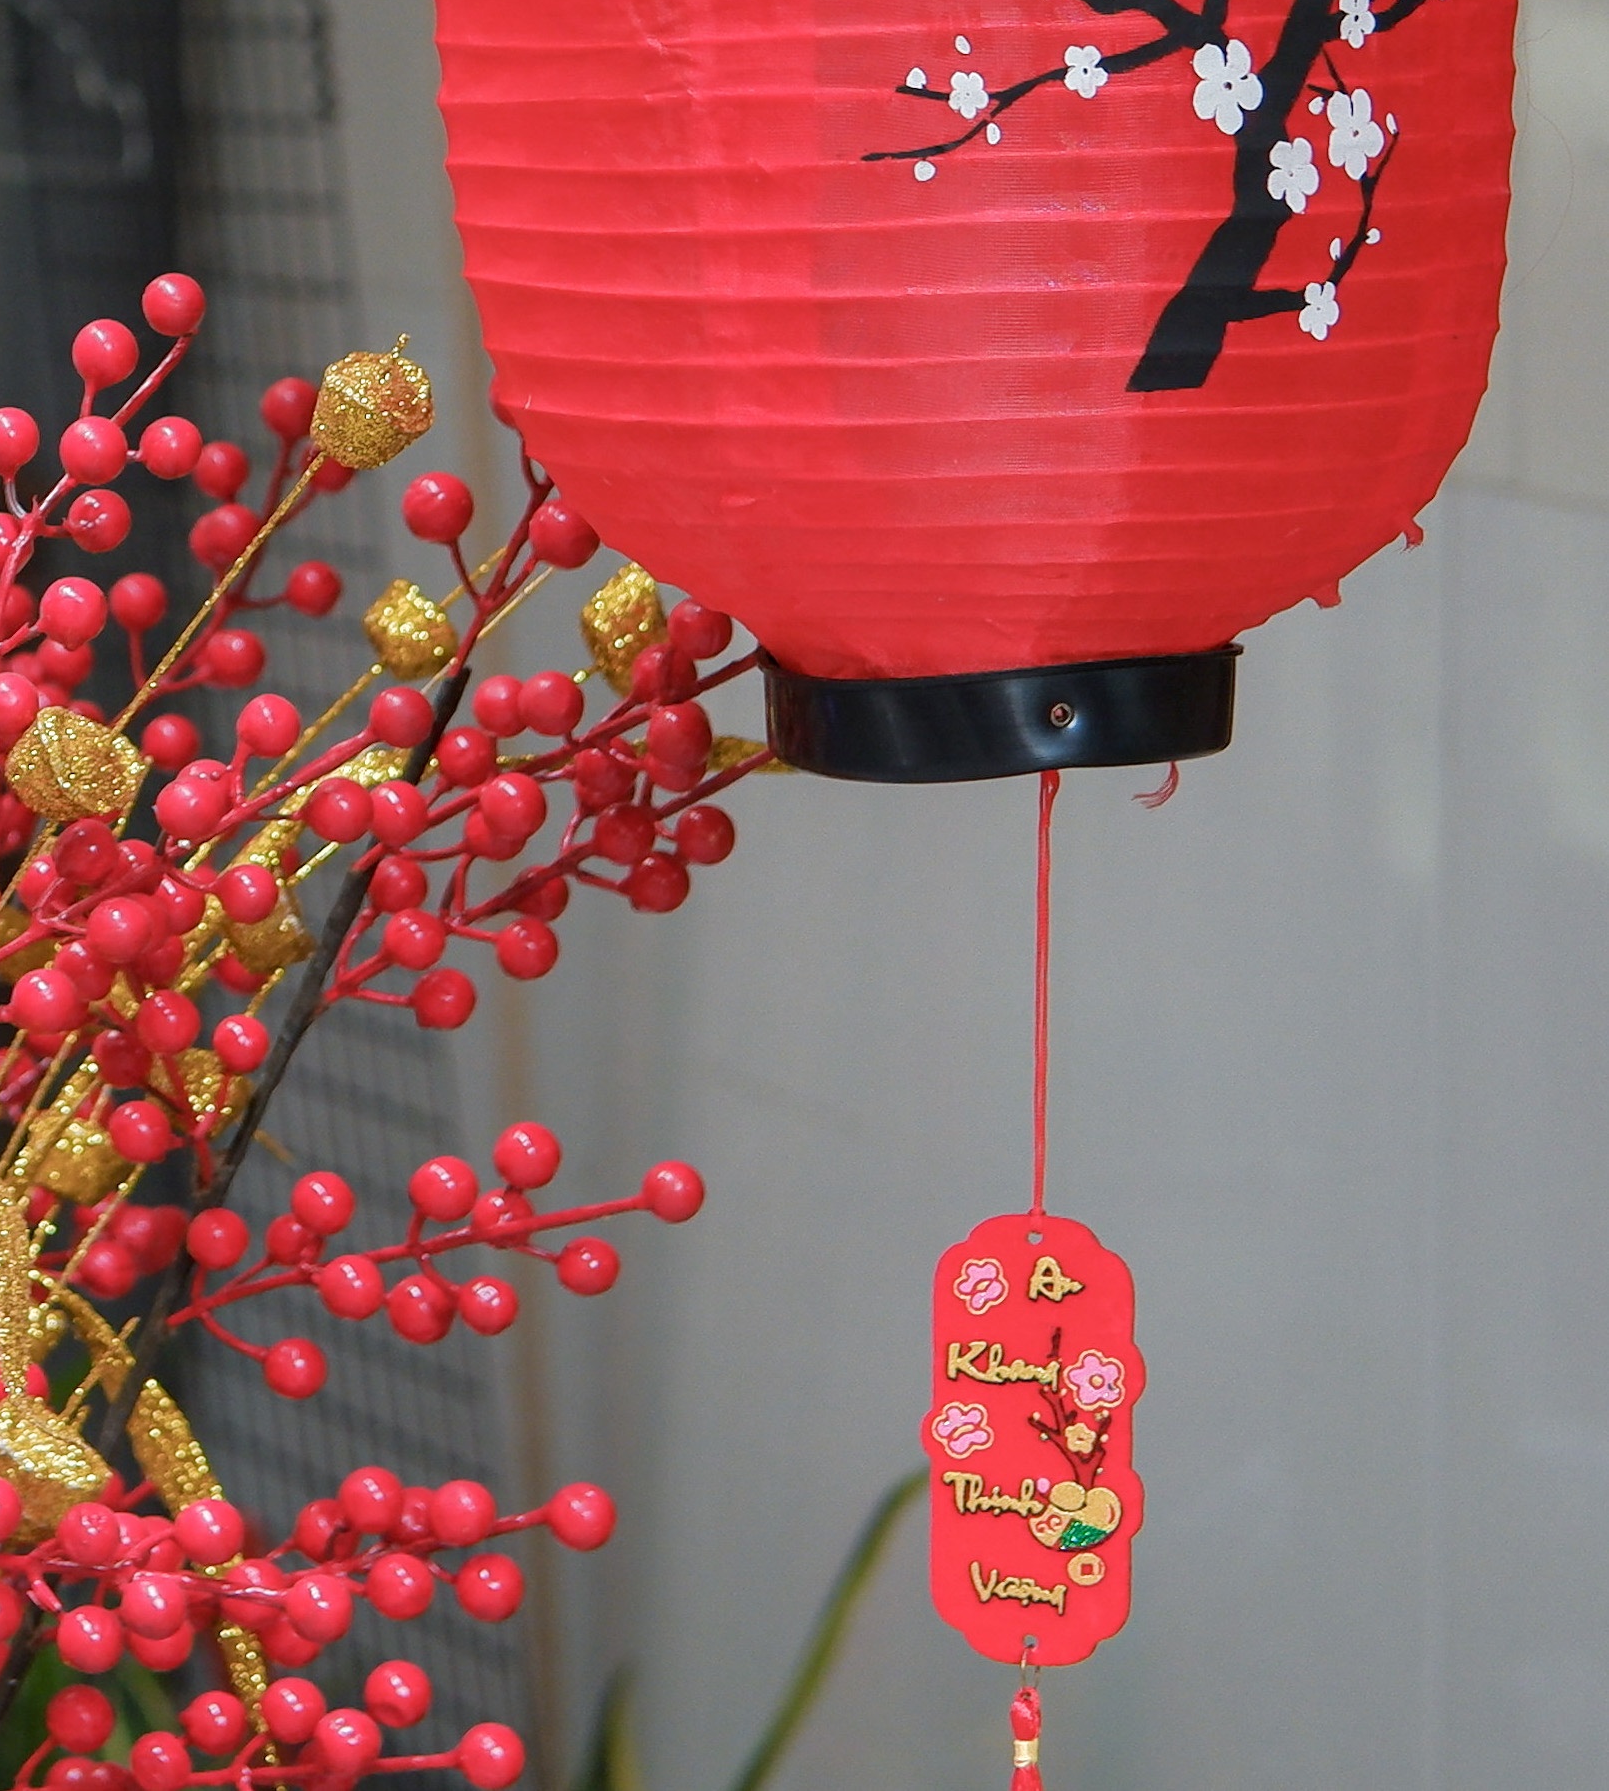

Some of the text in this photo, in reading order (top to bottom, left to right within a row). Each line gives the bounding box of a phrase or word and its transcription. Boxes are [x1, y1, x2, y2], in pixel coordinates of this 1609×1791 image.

[1028, 1256, 1085, 1302] An
[947, 1341, 1061, 1392] Khang
[942, 1471, 1045, 1517] Thịnh
